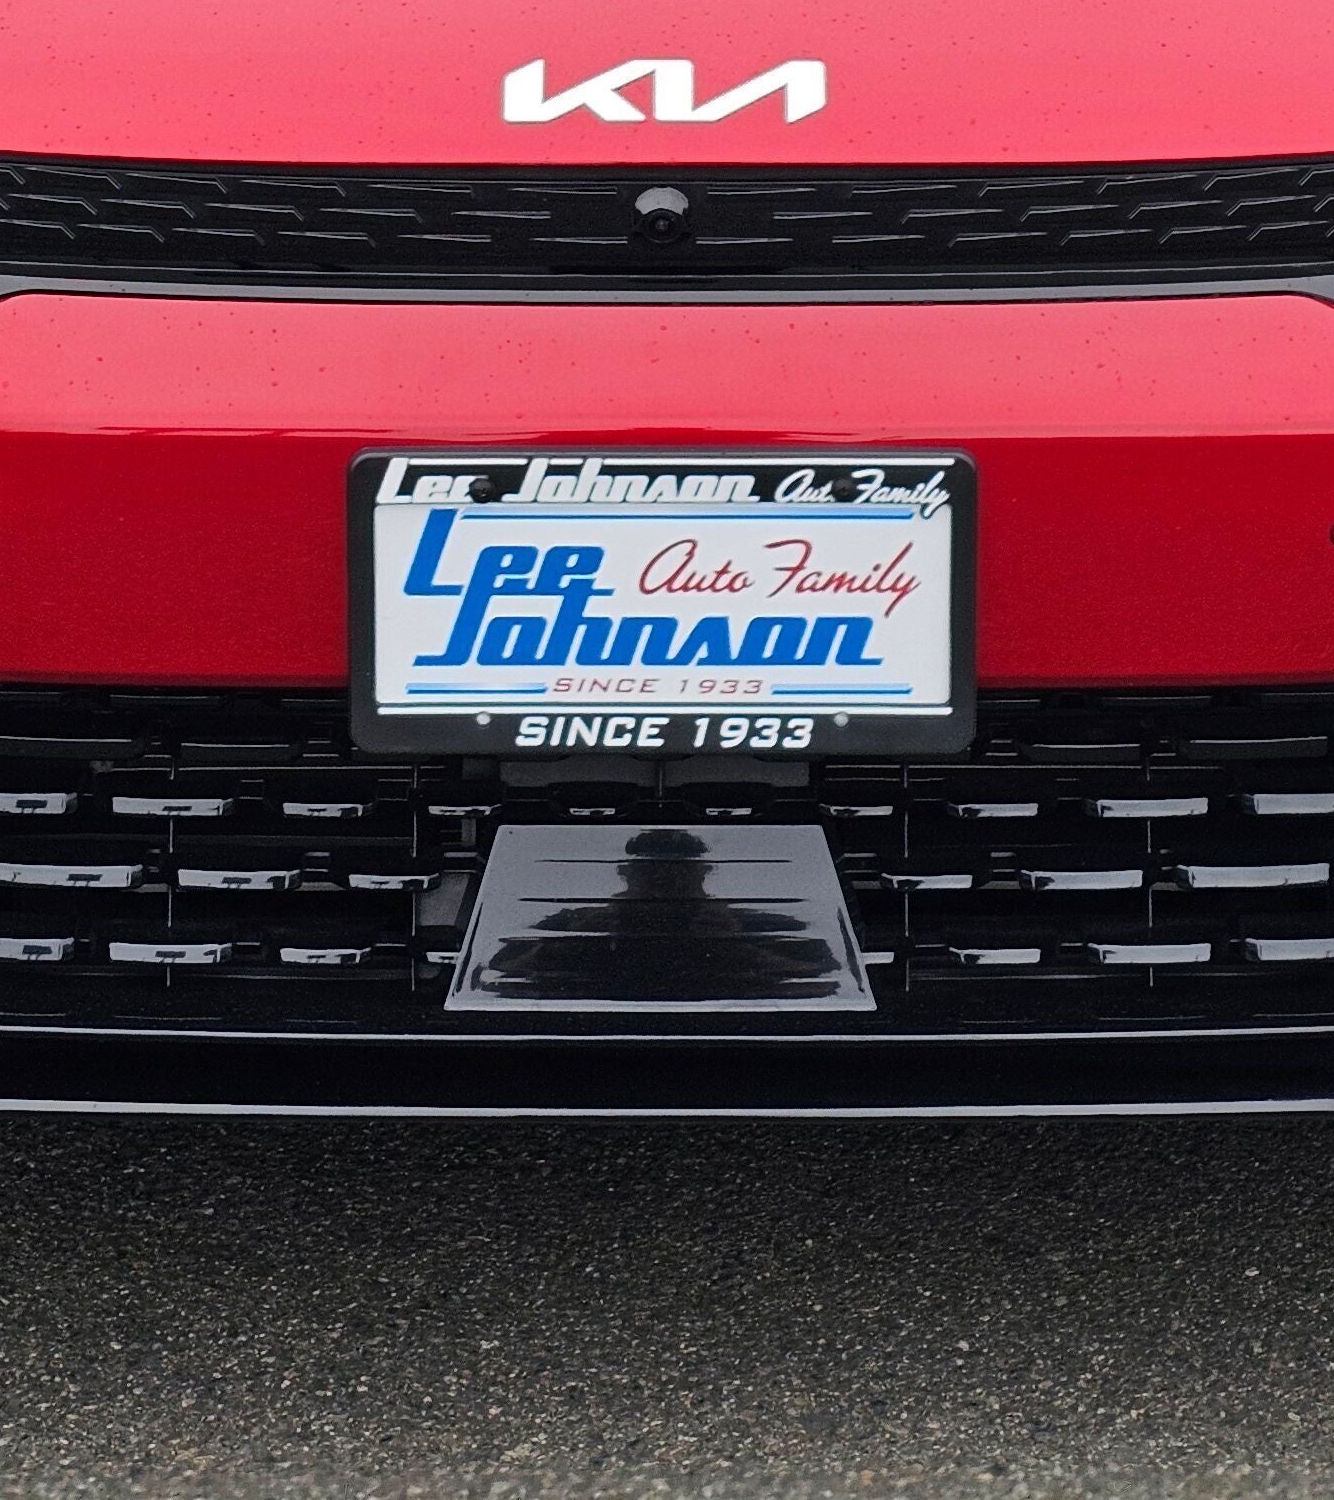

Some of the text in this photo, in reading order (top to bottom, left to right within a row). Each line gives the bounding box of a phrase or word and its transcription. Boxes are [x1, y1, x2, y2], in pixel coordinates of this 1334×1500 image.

[501, 457, 761, 503] Johnson
[850, 468, 952, 520] Family
[404, 508, 616, 597] Lee
[639, 538, 922, 618] Auto Family
[412, 585, 884, 666] Johnson
[553, 677, 764, 694] SINCE 1933
[515, 715, 815, 748] SINCE 1933
